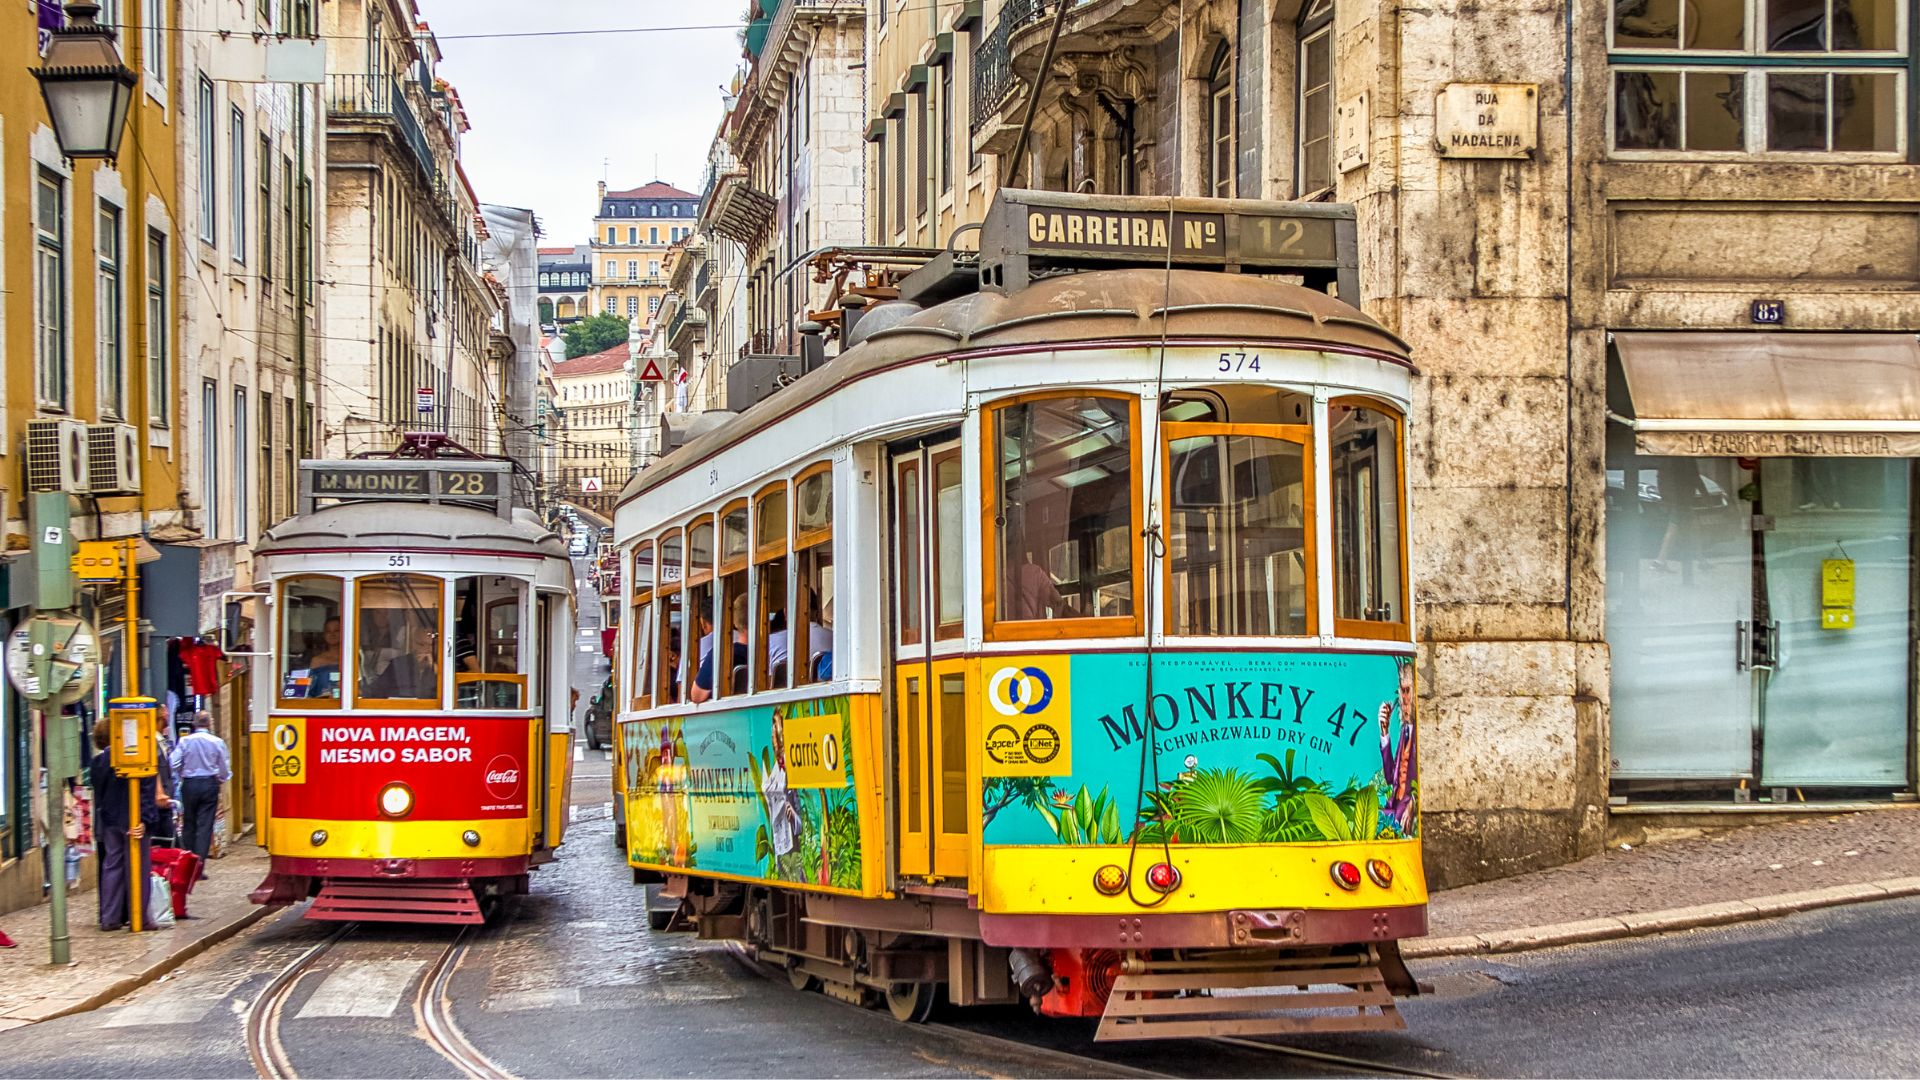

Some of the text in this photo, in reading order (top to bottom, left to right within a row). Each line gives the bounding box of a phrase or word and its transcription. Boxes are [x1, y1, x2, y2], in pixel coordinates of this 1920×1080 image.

[1475, 93, 1499, 105] RUA
[1478, 114, 1495, 126] DA
[1452, 134, 1521, 147] MADALENA
[1028, 212, 1168, 249] CARREIRA
[1257, 218, 1305, 256] 12
[1218, 352, 1261, 372] 574
[1690, 434, 1707, 454] LA
[320, 473, 485, 495] M. MONIZ 28
[388, 555, 411, 567] 551
[1097, 681, 1368, 752] MONKEY 47
[321, 726, 471, 744] NOVA IMAGEM,
[1154, 725, 1333, 756] SCHWARZWALD DRY GIN
[320, 747, 472, 763] MESMO SABOR
[789, 731, 819, 767] carris
[691, 767, 750, 804] MONKEY 47
